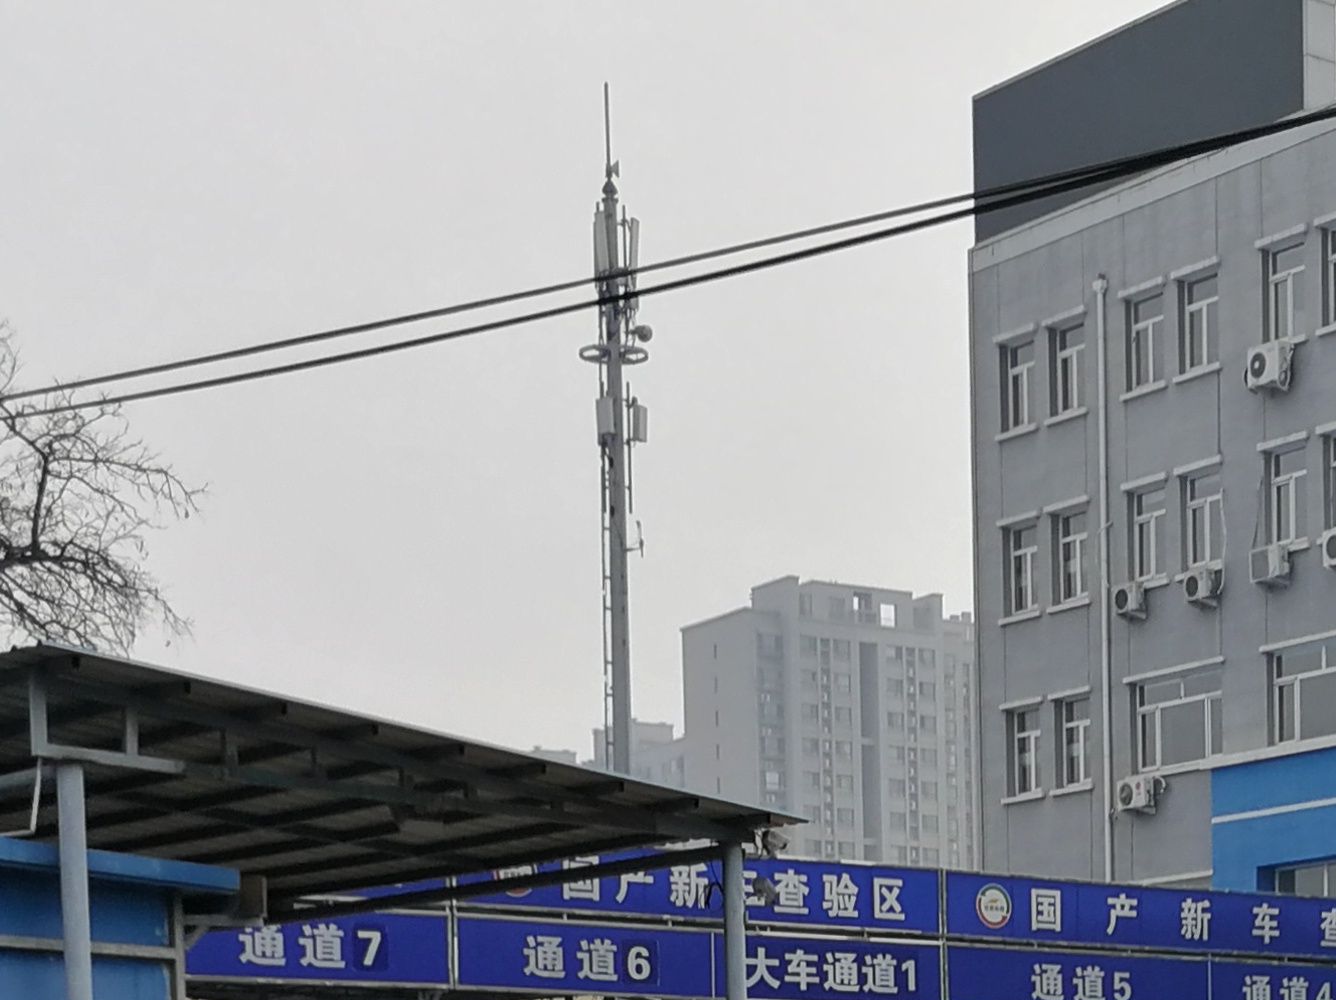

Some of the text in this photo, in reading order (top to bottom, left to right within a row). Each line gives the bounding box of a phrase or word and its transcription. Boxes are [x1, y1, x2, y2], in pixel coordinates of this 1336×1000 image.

[238, 923, 382, 969] 通道7
[522, 935, 651, 982] 通道6
[745, 947, 918, 995] 大车通道1
